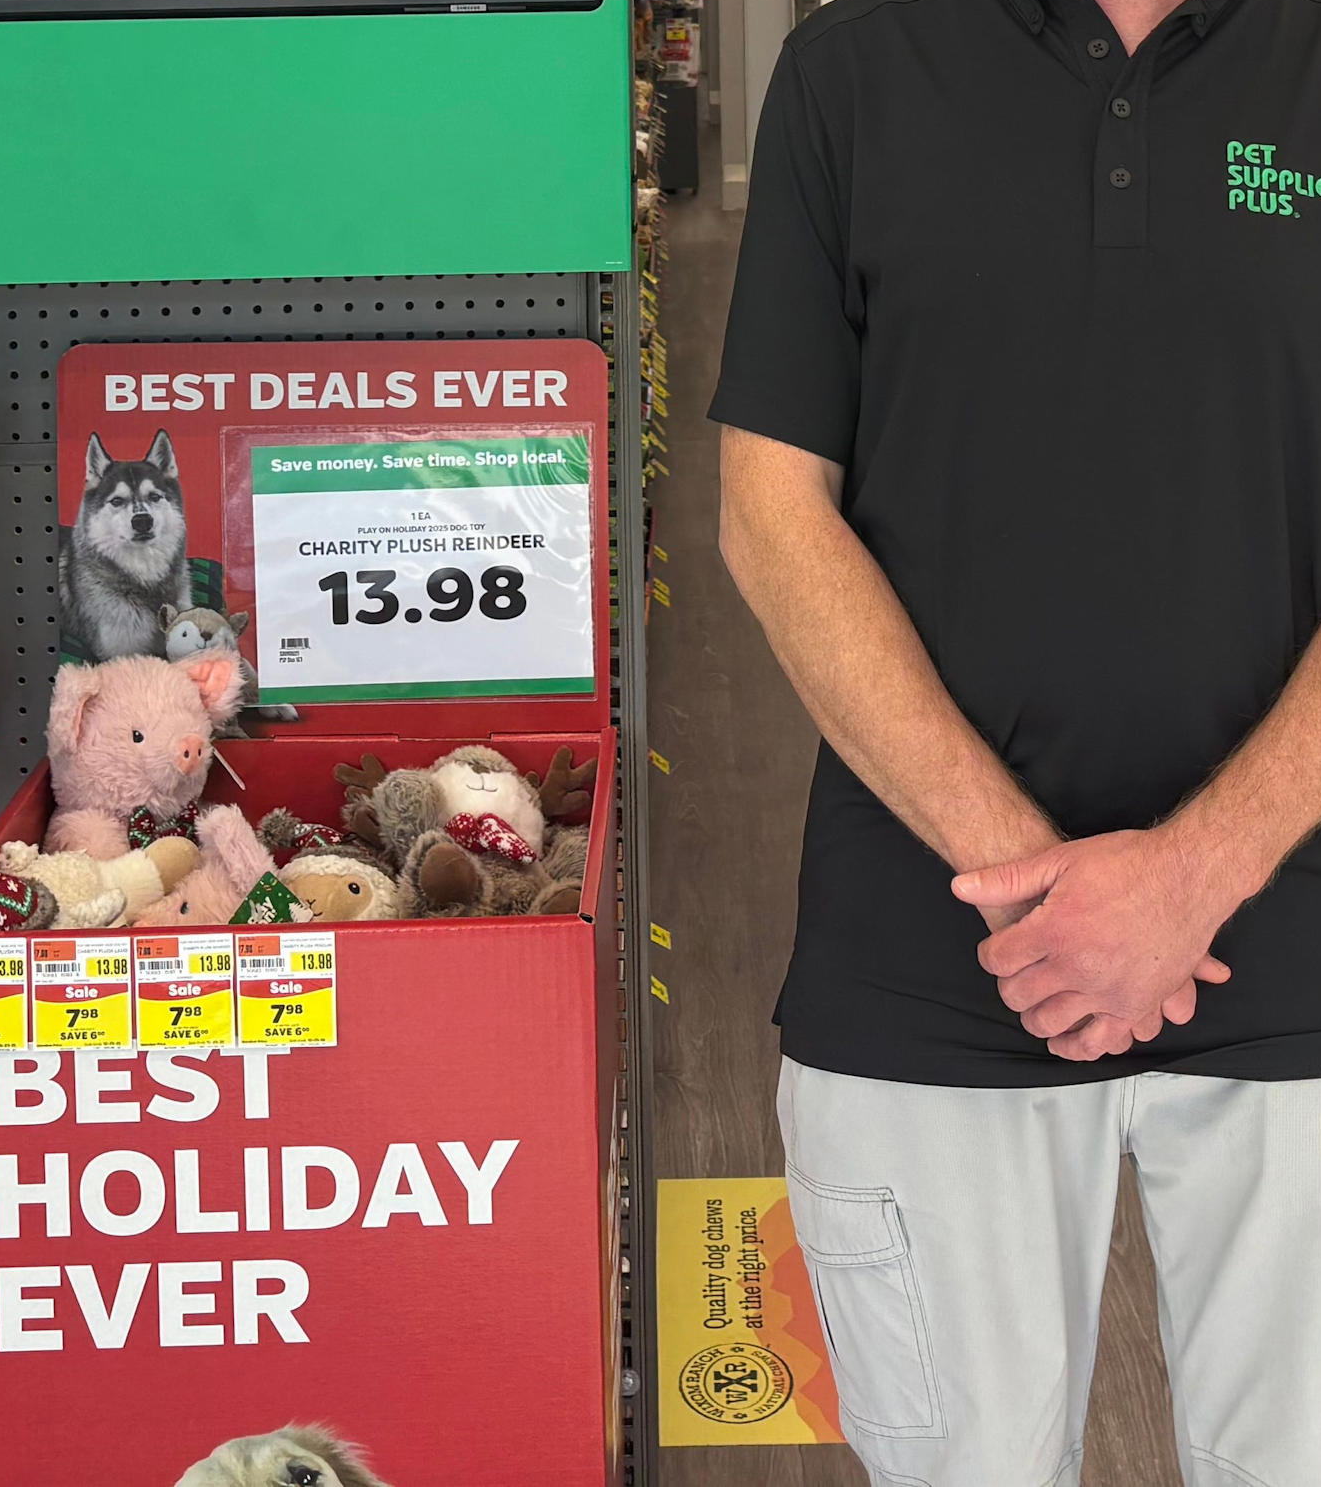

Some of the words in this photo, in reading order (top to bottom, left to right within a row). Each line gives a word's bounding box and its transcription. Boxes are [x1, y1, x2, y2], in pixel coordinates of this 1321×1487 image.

[1227, 141, 1276, 165] PET
[1229, 189, 1293, 216] PLUS
[105, 374, 235, 412] BEST
[250, 371, 417, 410] DEALS
[434, 370, 568, 408] EVER
[271, 459, 312, 472] Save
[317, 457, 378, 473] money.
[382, 455, 423, 469] Save
[428, 453, 470, 467] time.
[475, 452, 518, 467] Shop
[522, 450, 566, 464] local.
[298, 540, 382, 556] CHARITY
[387, 539, 446, 554] PLUSH
[453, 535, 546, 551] REINDEER
[318, 566, 527, 625] 13.98
[702, 1199, 723, 1240] chews
[735, 1206, 764, 1244] price.
[703, 1243, 730, 1270] dog
[737, 1248, 765, 1281] right
[703, 1272, 731, 1330] Quality
[739, 1286, 761, 1310] the
[742, 1314, 763, 1329] at
